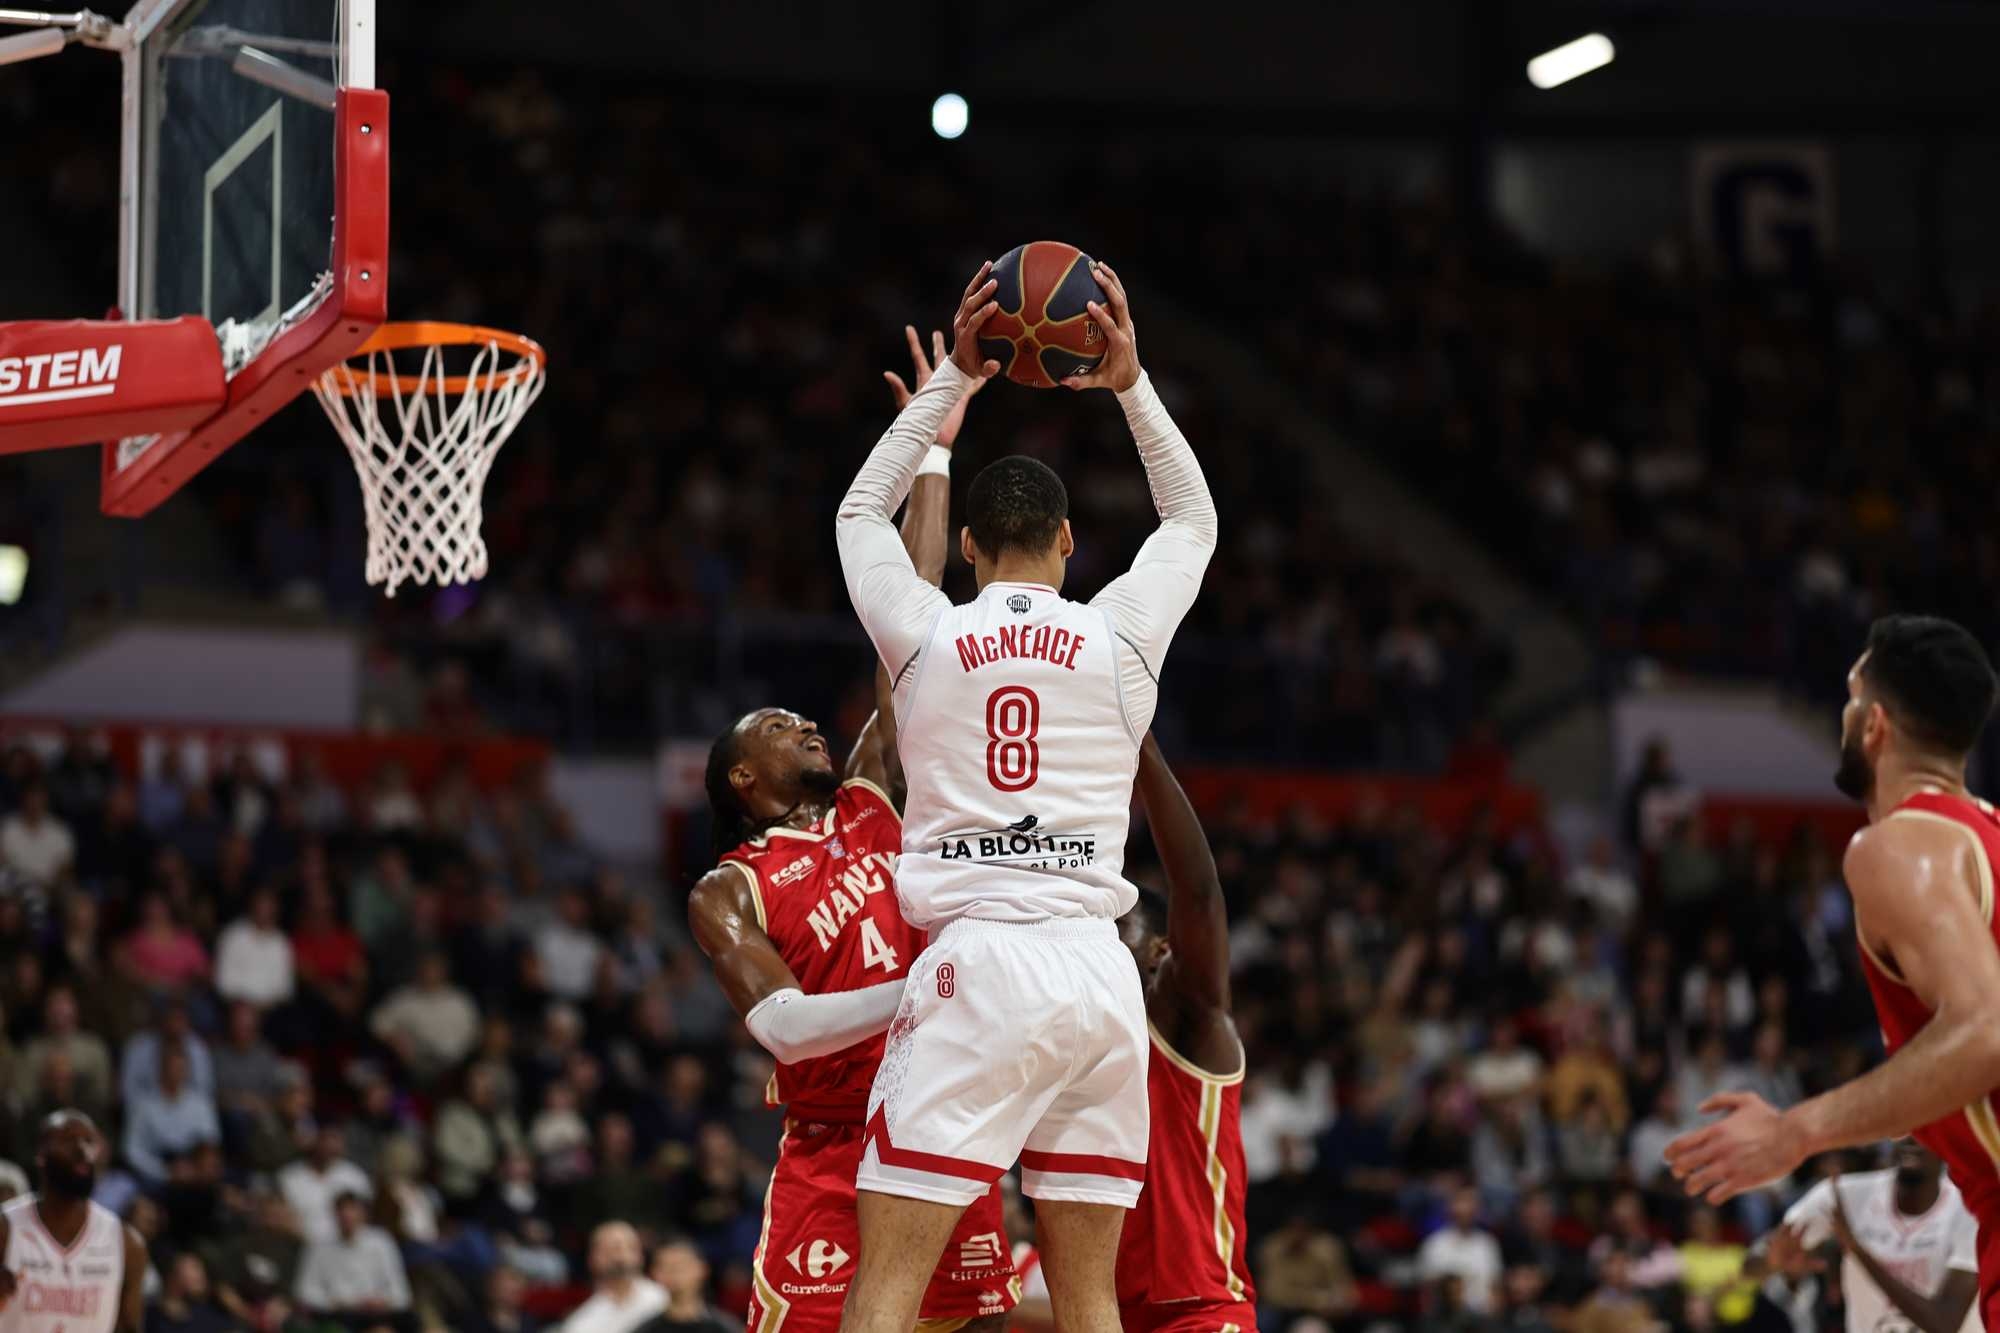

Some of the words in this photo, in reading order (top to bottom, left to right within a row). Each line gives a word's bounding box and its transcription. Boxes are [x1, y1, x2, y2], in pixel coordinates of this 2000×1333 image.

[955, 624, 1085, 673] McNEACE
[986, 685, 1040, 793] 8
[941, 839, 972, 860] LA
[806, 851, 896, 953] NANCY
[859, 916, 900, 973] 4
[936, 962, 955, 999] 8
[781, 1281, 847, 1295] Carrefour
